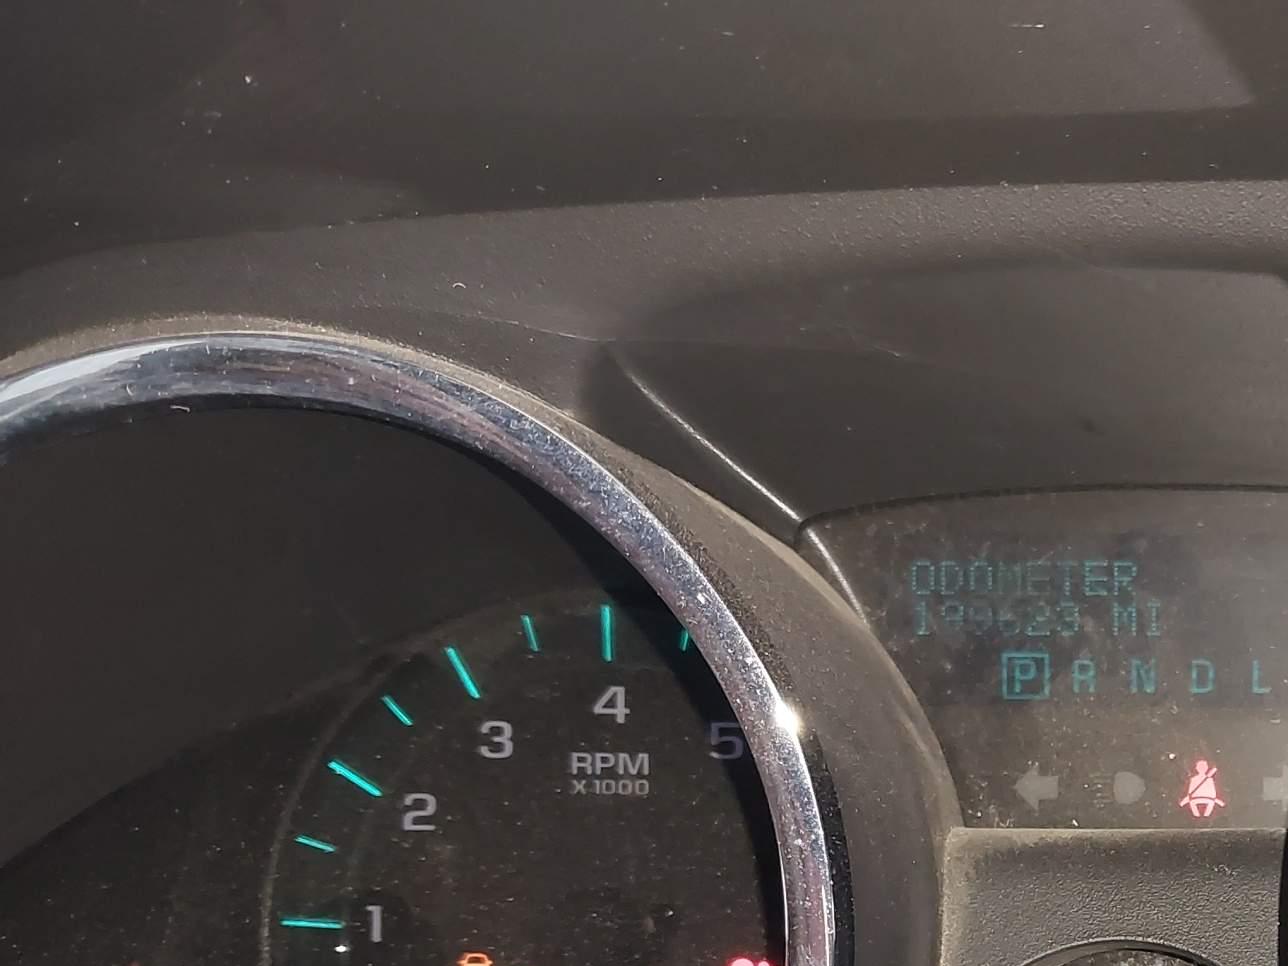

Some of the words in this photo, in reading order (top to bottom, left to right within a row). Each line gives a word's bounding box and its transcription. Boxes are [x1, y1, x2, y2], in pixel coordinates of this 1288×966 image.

[911, 561, 1137, 596] ODOMETER
[1113, 601, 1162, 635] MI
[1013, 659, 1036, 694] P
[1072, 660, 1096, 695] R
[1131, 659, 1157, 695] N
[1191, 660, 1216, 694] D
[1251, 661, 1273, 694] L
[594, 686, 630, 723] 4
[480, 721, 513, 759] 3
[709, 721, 744, 760] 5
[571, 752, 650, 775] RPM
[403, 794, 436, 831] 2
[365, 905, 385, 943] 1
